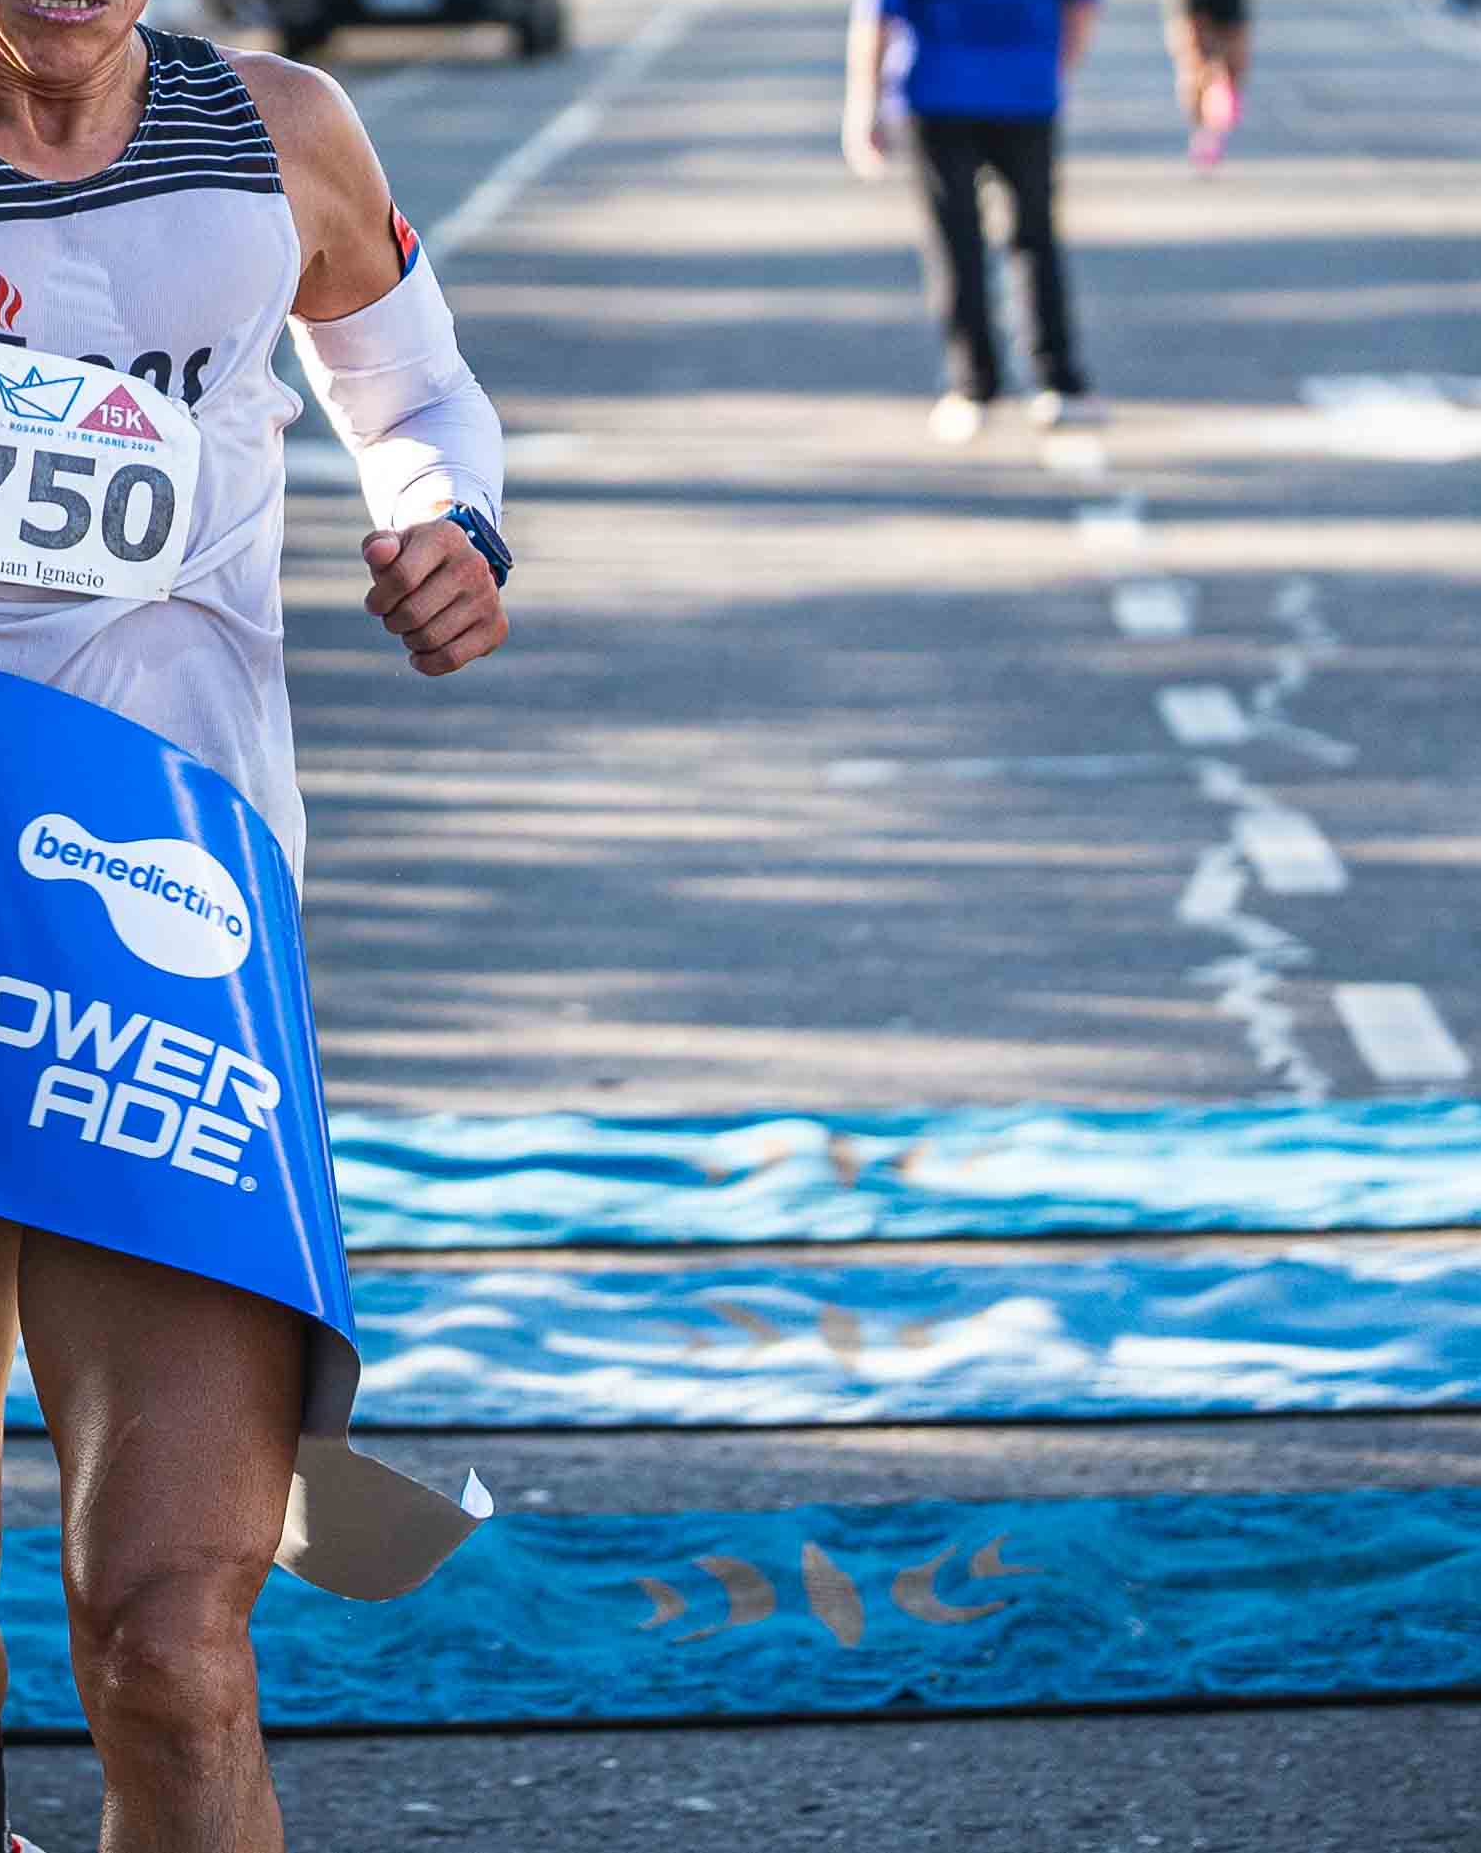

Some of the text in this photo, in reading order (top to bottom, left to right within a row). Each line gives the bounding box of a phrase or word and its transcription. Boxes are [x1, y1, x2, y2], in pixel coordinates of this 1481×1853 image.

[99, 403, 143, 431] 15K
[10, 422, 54, 436] ROSARIO
[81, 433, 93, 443] DE
[98, 435, 127, 449] ABRIL
[35, 560, 105, 589] Ignacio
[33, 826, 243, 937] benedictino
